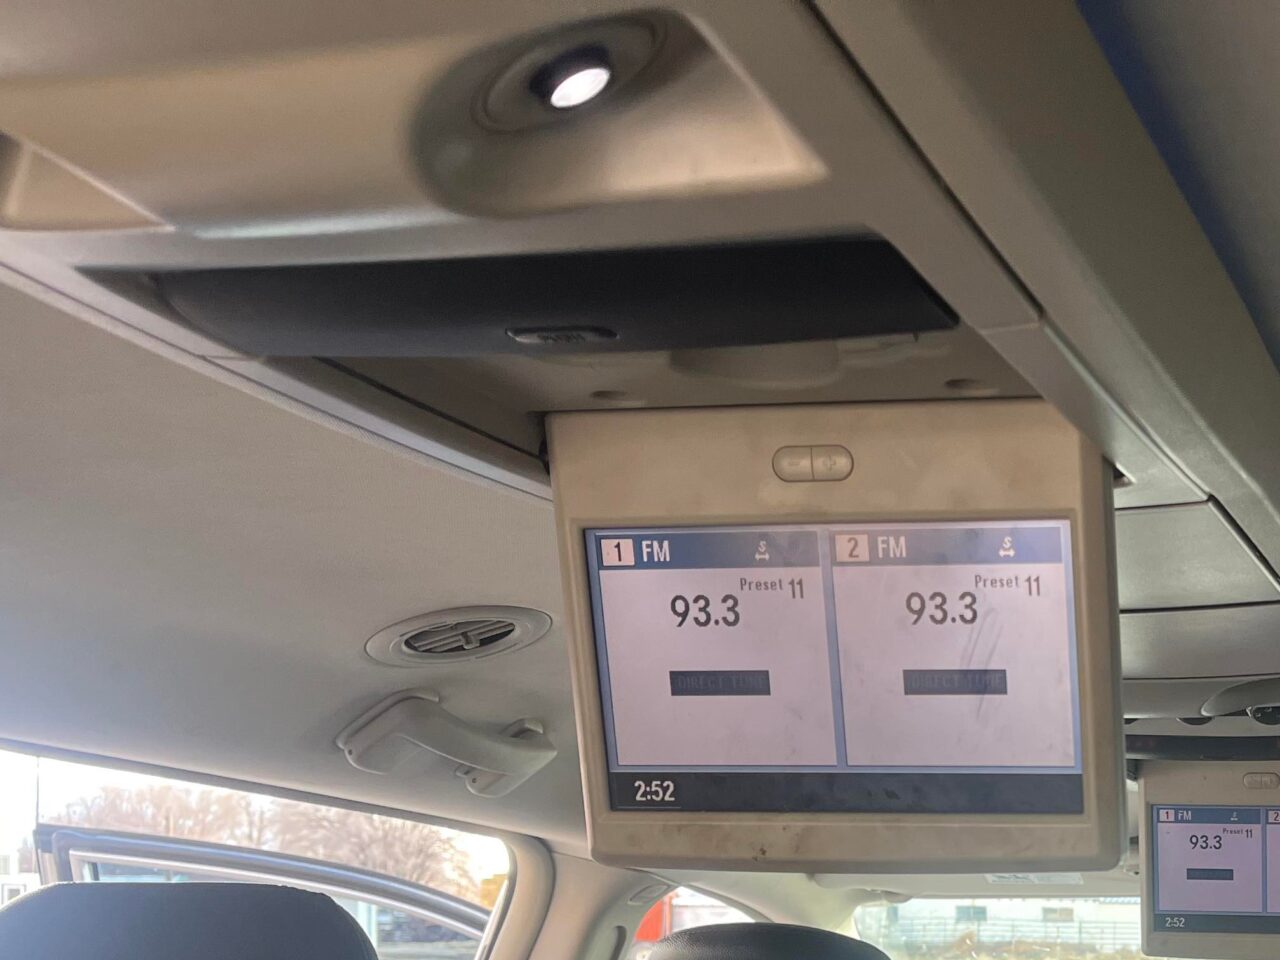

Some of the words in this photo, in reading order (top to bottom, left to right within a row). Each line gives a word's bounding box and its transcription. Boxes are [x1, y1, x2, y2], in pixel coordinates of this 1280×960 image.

[612, 541, 622, 562] 1
[641, 540, 671, 562] FM
[847, 537, 860, 558] 2
[877, 536, 907, 558] FM
[739, 577, 784, 592] Preset
[788, 578, 804, 599] 11
[974, 574, 1019, 589] Preset
[1024, 575, 1041, 596] 11
[670, 594, 740, 627] 93.3
[905, 591, 978, 625] 93.3
[634, 780, 676, 801] 2:52
[1177, 810, 1192, 821] FM
[1189, 834, 1223, 850] 93.3
[1245, 829, 1253, 838] 11
[1165, 917, 1186, 928] 2:52
